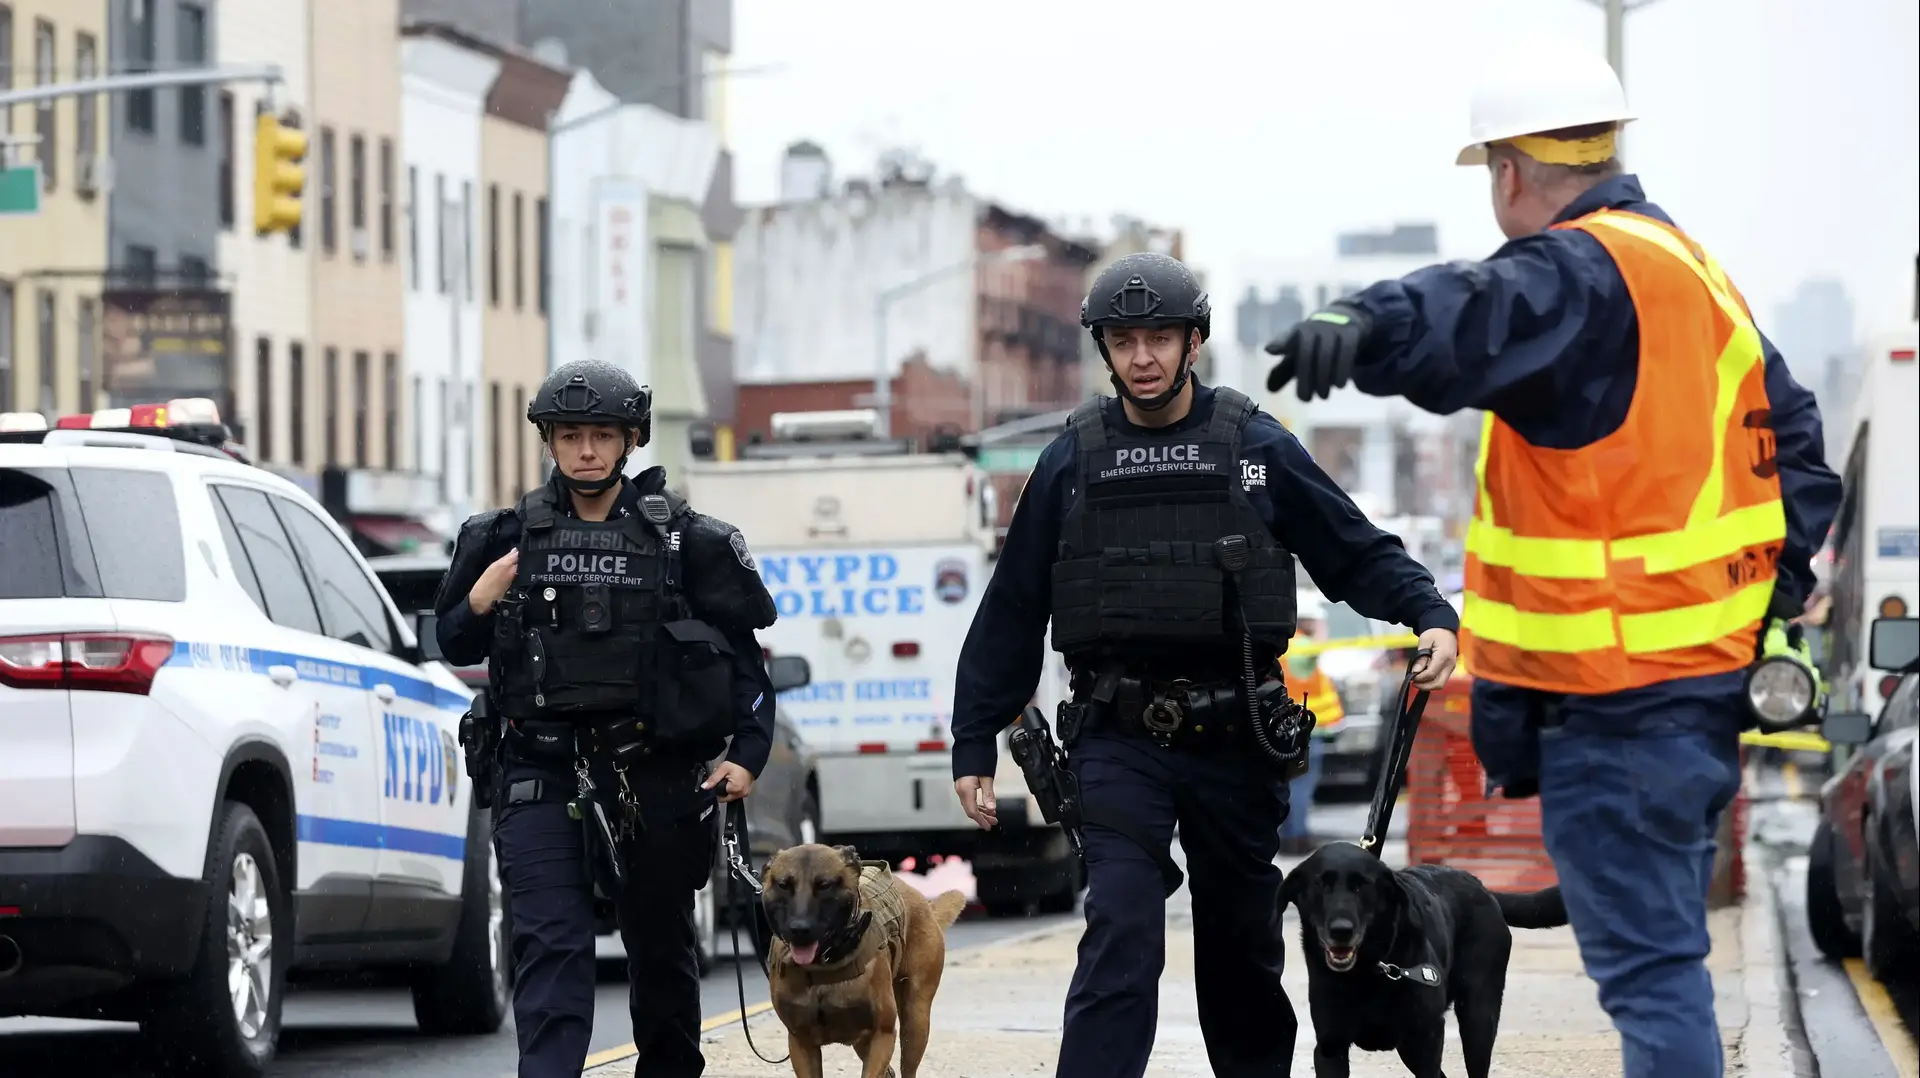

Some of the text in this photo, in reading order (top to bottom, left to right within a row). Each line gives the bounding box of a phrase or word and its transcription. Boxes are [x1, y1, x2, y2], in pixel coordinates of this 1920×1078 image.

[1116, 444, 1200, 466] POLICE
[1100, 462, 1217, 478] EMERGENCY SERVICE UNIT
[1241, 464, 1267, 480] ICE
[547, 554, 628, 575] POLICE
[760, 552, 899, 586] NYPD
[584, 574, 620, 584] SERVICE
[621, 576, 643, 586] UNIT
[773, 585, 926, 618] OLICE
[383, 711, 444, 806] NYPD
